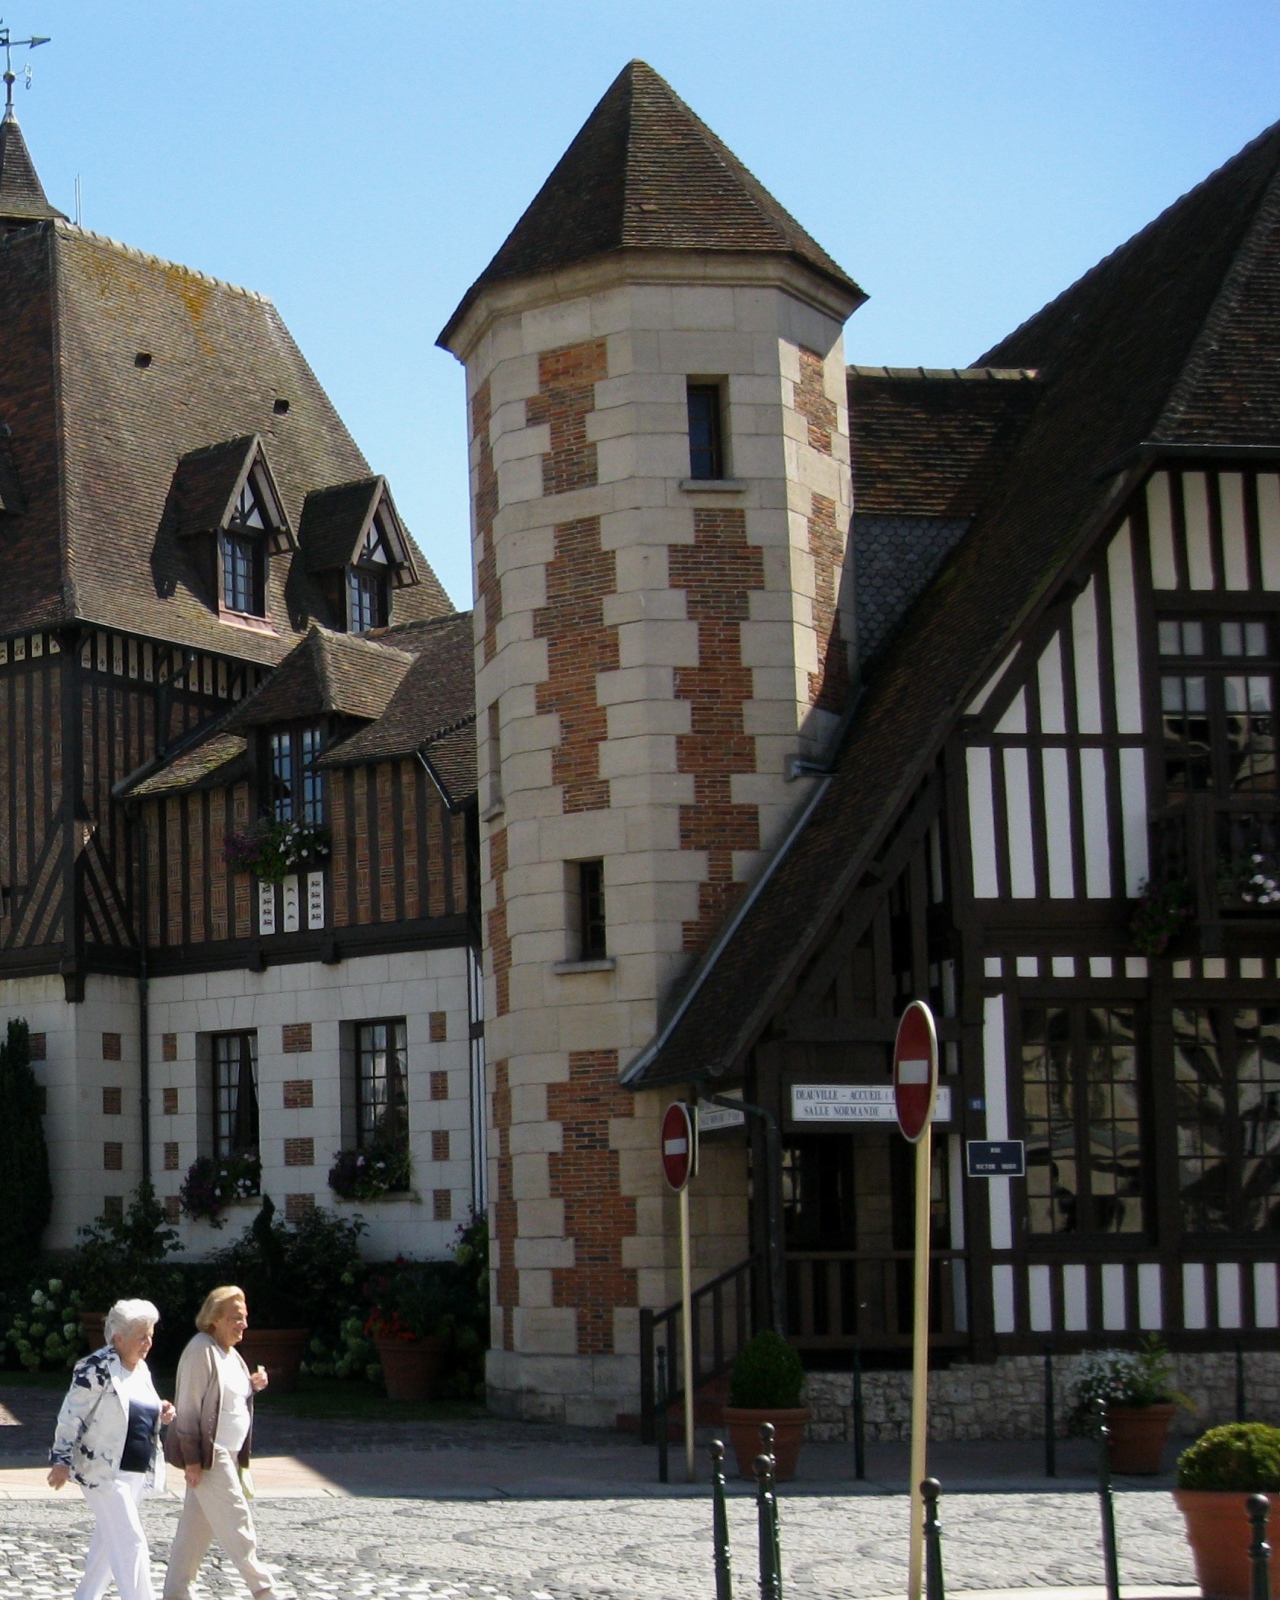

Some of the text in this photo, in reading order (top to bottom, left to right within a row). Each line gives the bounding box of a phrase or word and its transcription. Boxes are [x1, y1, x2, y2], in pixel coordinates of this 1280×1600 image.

[796, 1090, 838, 1101] DEAUVILLE
[850, 1090, 881, 1101] ACCUEIL
[804, 1106, 830, 1117] SALLE
[833, 1106, 880, 1117] NORMANDE
